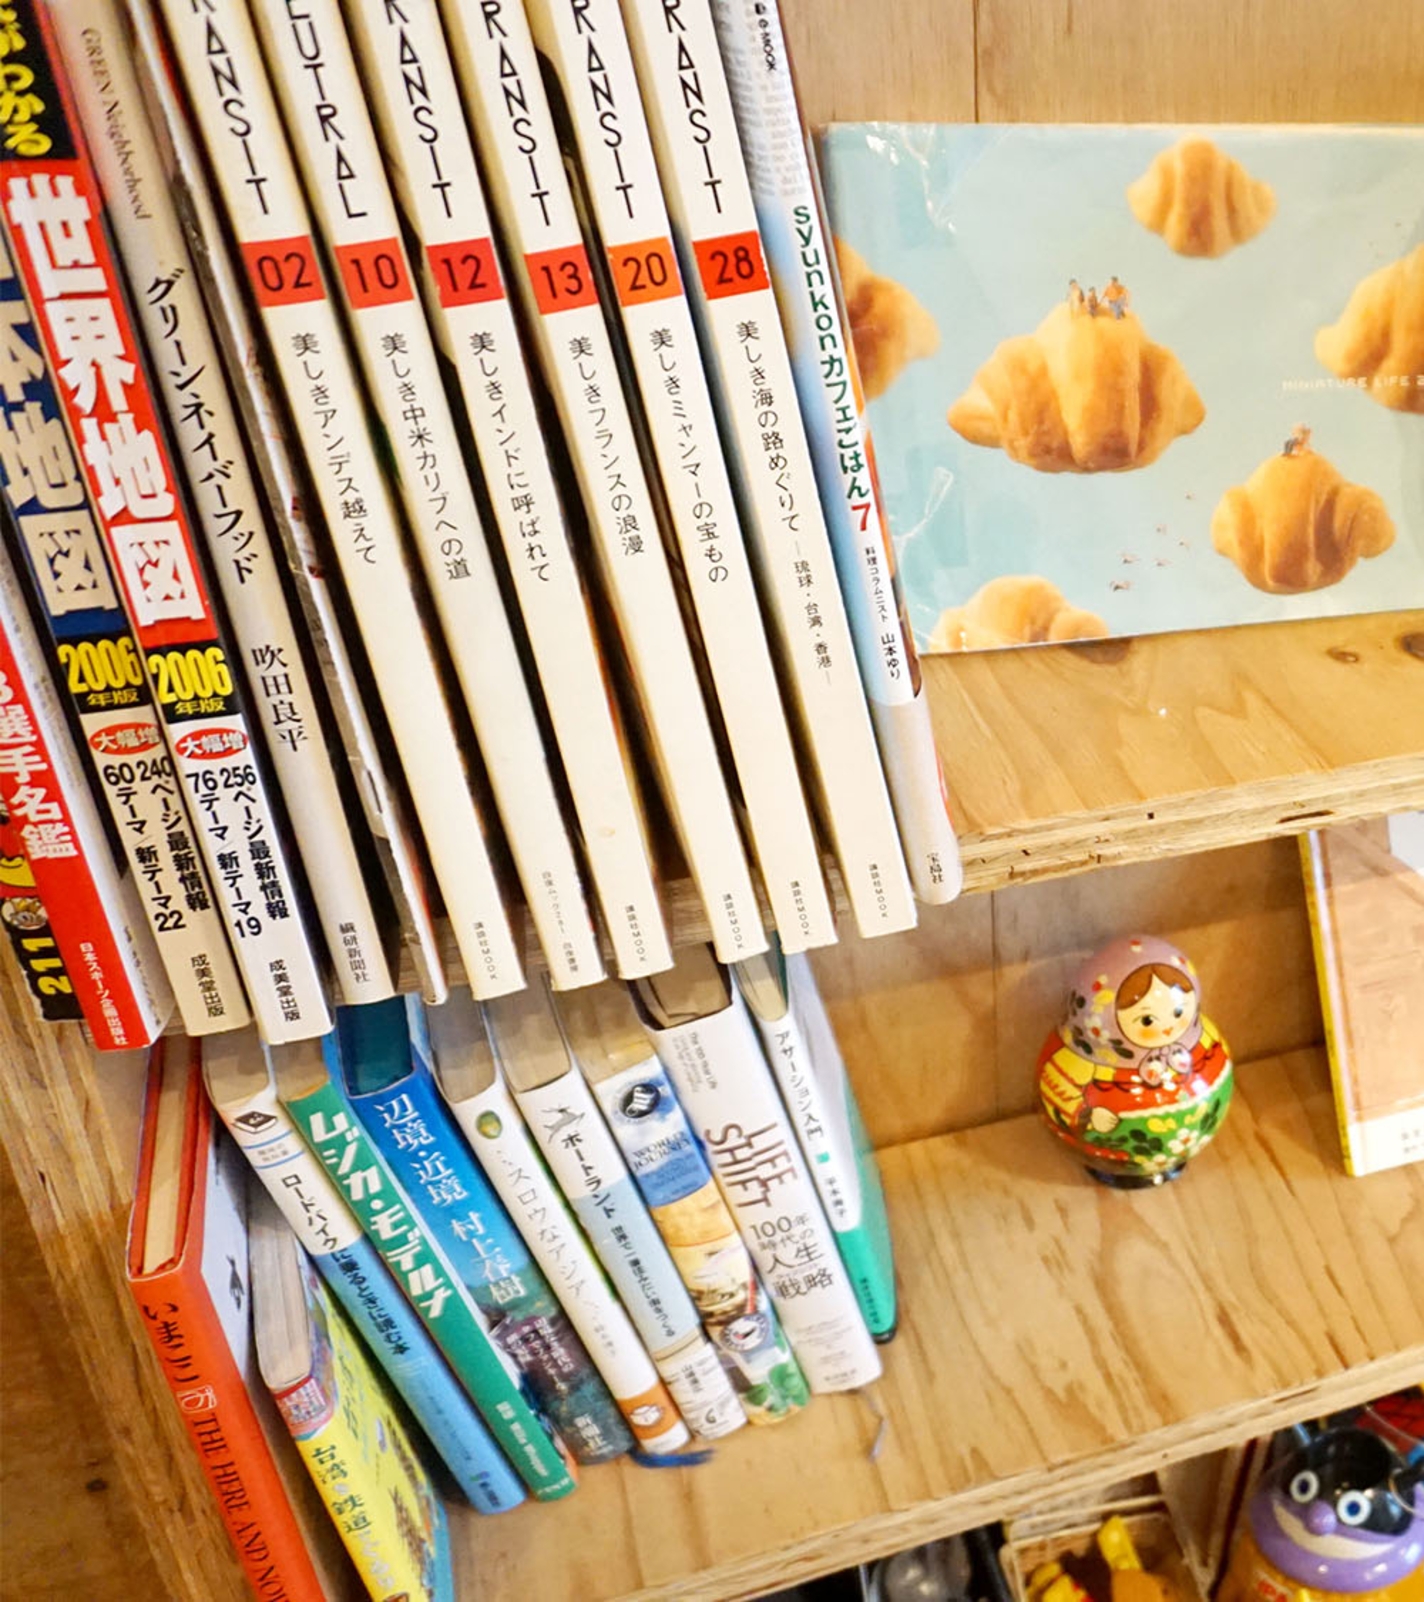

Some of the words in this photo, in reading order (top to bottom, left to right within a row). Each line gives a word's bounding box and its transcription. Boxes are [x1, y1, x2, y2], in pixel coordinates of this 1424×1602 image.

[480, 2, 551, 227] RANSIT
[257, 253, 312, 292] 02
[350, 254, 400, 293] 10
[443, 254, 486, 292] 12
[541, 260, 584, 299] 13
[622, 252, 667, 291] 20
[709, 246, 755, 285] 28
[9, 173, 206, 628] 世界地図
[1373, 375, 1410, 388] LIFE
[0, 222, 119, 616] 本地図
[146, 268, 259, 585] グリーンネイバーフッド
[291, 332, 377, 565] 美しきアンデス越えて
[569, 336, 645, 556] 美しきフランスの浪漫
[735, 320, 801, 533] 美しき海の路めぐりて
[381, 332, 471, 580] 美しき中米カリブへの道
[469, 331, 551, 582] 美しきインドに呼ばれて
[649, 327, 729, 583] 美しきミャンマーの宝もの
[865, 547, 889, 623] 料理コラムニスト
[881, 633, 901, 680] 山本ゆり
[56, 636, 145, 695] 2006
[149, 647, 234, 705] 2006
[86, 688, 140, 708] 年版
[174, 699, 227, 716] 年版
[251, 644, 309, 753] 吹田良平
[93, 723, 161, 752] 大幅増
[180, 730, 248, 758] 大幅増
[338, 923, 370, 984] 繊研新聞社
[79, 942, 128, 1046] 日本スポーツ企画出版社
[190, 953, 226, 1018] 成美堂出版
[268, 958, 302, 1022] 成美堂出版
[774, 1032, 825, 1139] アサーション入門
[632, 1131, 686, 1160] WORLD
[632, 1139, 692, 1171] JOURNEY
[704, 1123, 772, 1208] SHIFT
[743, 1122, 799, 1192] LIFE
[308, 1110, 453, 1319] ムジカ・モデルナ
[373, 1093, 468, 1206] 辺境・近境
[450, 1210, 527, 1305] 村上春樹
[750, 1212, 809, 1241] 100年
[759, 1229, 815, 1252] 時代の
[766, 1242, 825, 1275] 人生
[772, 1267, 835, 1300] 戦略
[143, 1302, 200, 1384] いまここ
[193, 1412, 230, 1459] THE
[211, 1461, 252, 1517] HERE
[235, 1520, 270, 1563] AND
